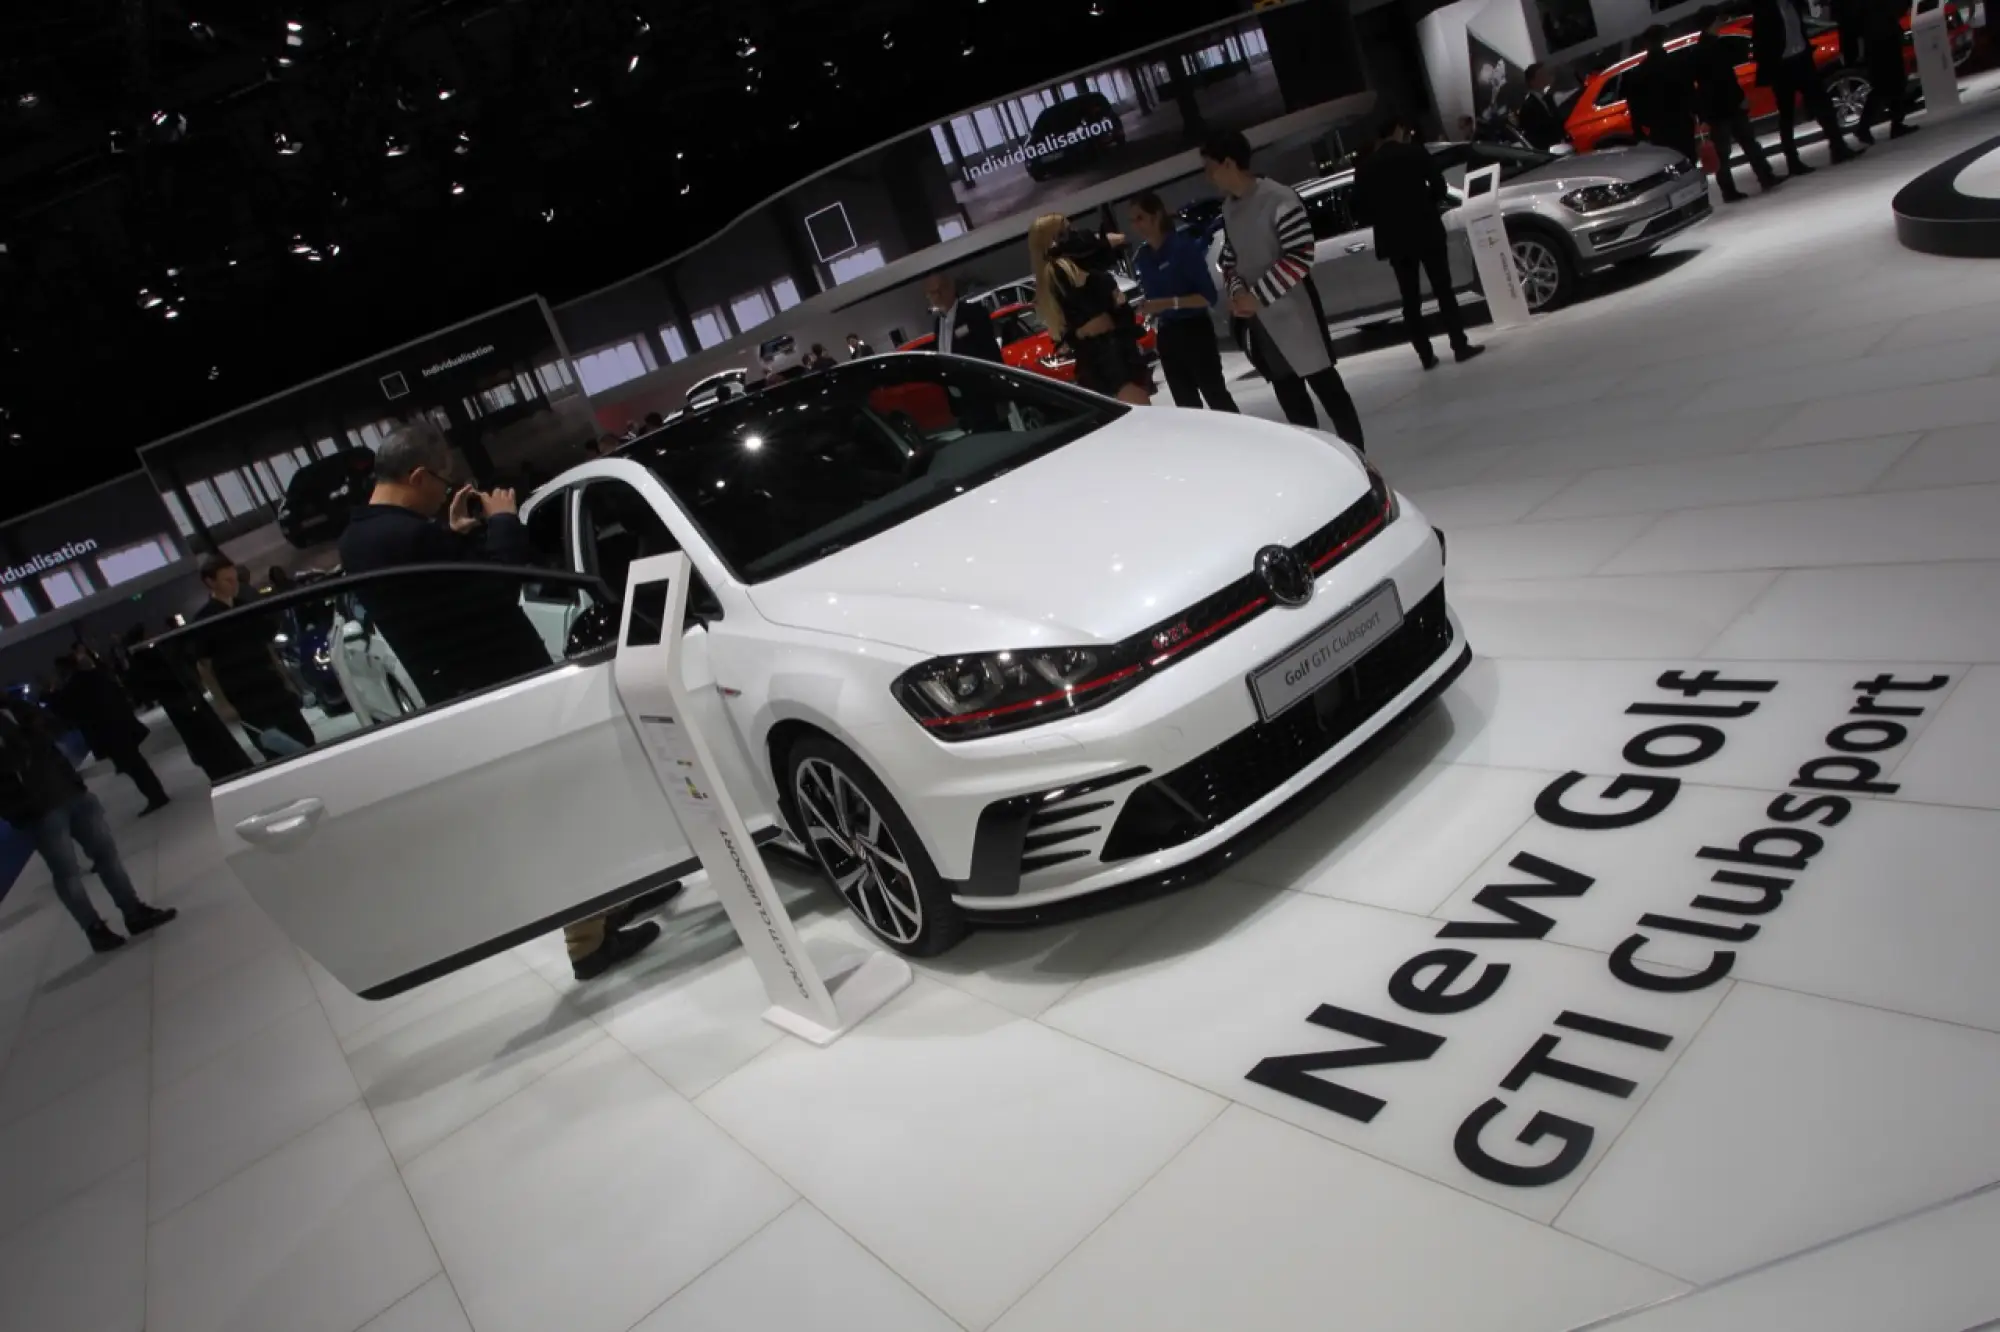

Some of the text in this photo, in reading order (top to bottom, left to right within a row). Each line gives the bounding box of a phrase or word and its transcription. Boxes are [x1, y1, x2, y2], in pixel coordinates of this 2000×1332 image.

[961, 116, 1114, 182] Individualisation
[1285, 611, 1380, 686] Golf GTI Clubsport
[1244, 669, 1779, 1124] New Golf
[1453, 673, 1951, 1188] GTI Clubsport
